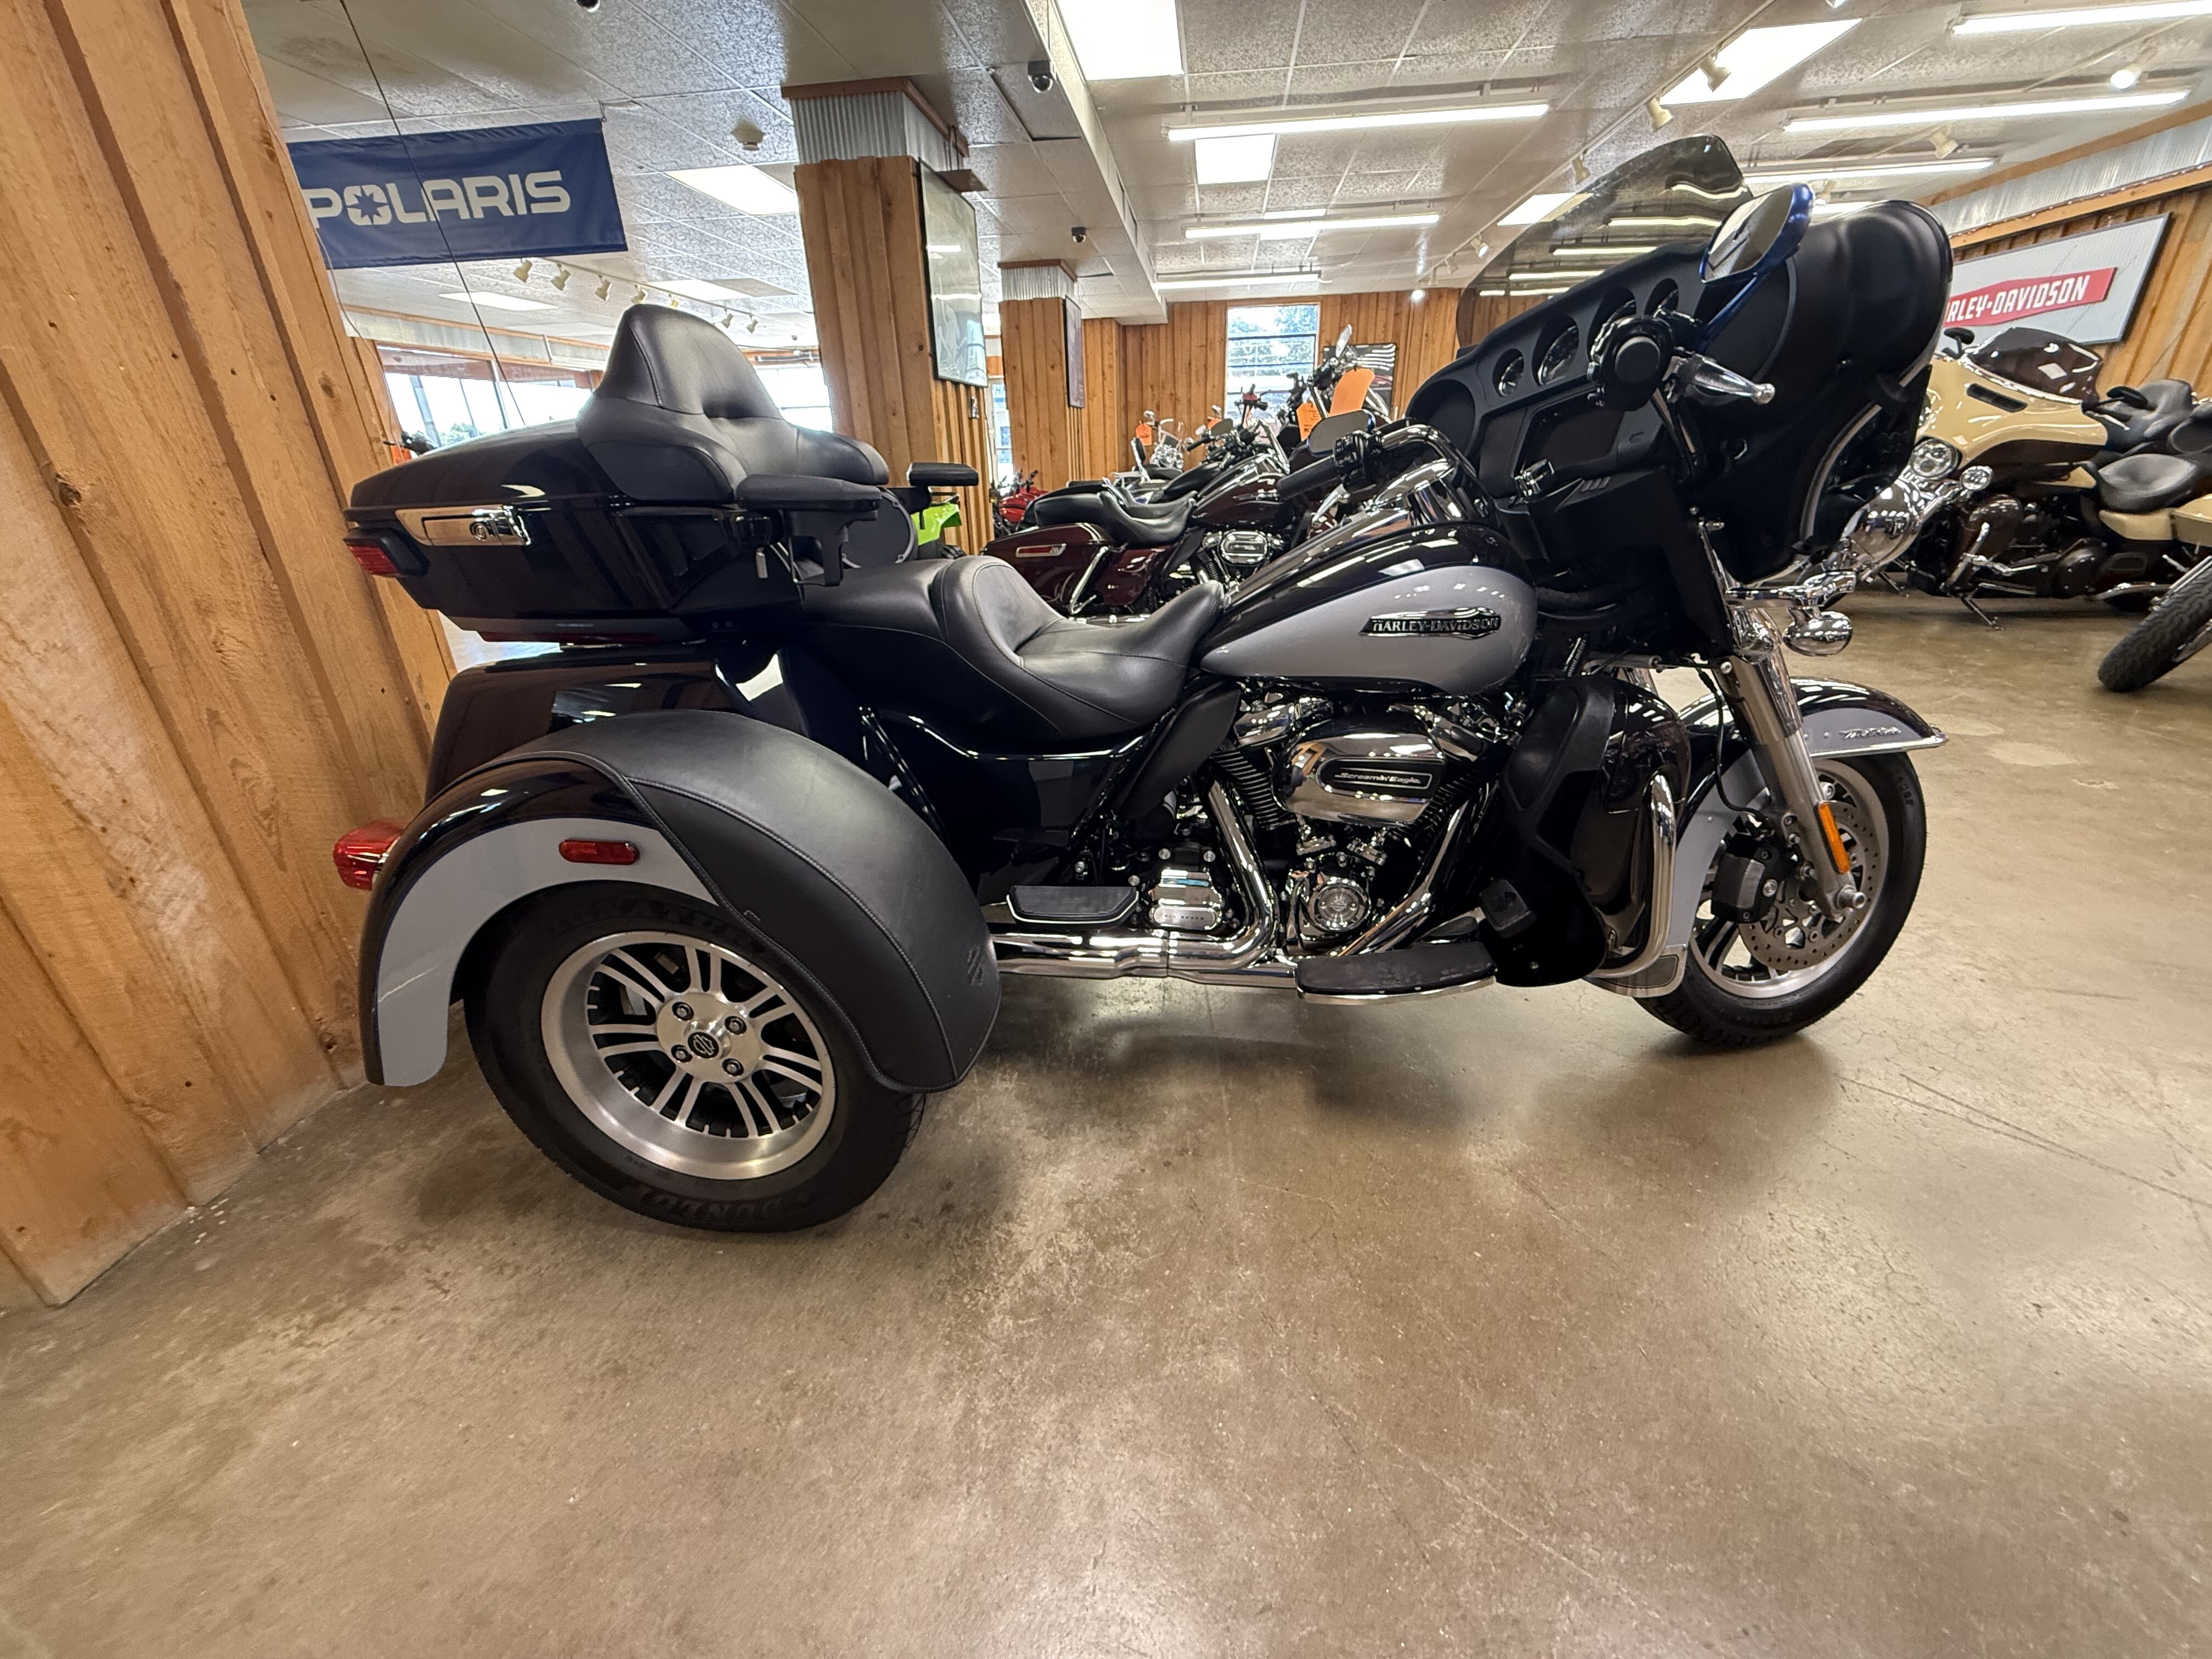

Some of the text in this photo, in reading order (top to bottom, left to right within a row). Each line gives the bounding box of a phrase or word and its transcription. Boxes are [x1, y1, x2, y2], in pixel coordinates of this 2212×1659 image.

[302, 170, 571, 228] POLARIS
[1946, 275, 2090, 323] RLEY-DAVIDSON
[1373, 618, 1499, 632] HARLEY-DAVIDSON
